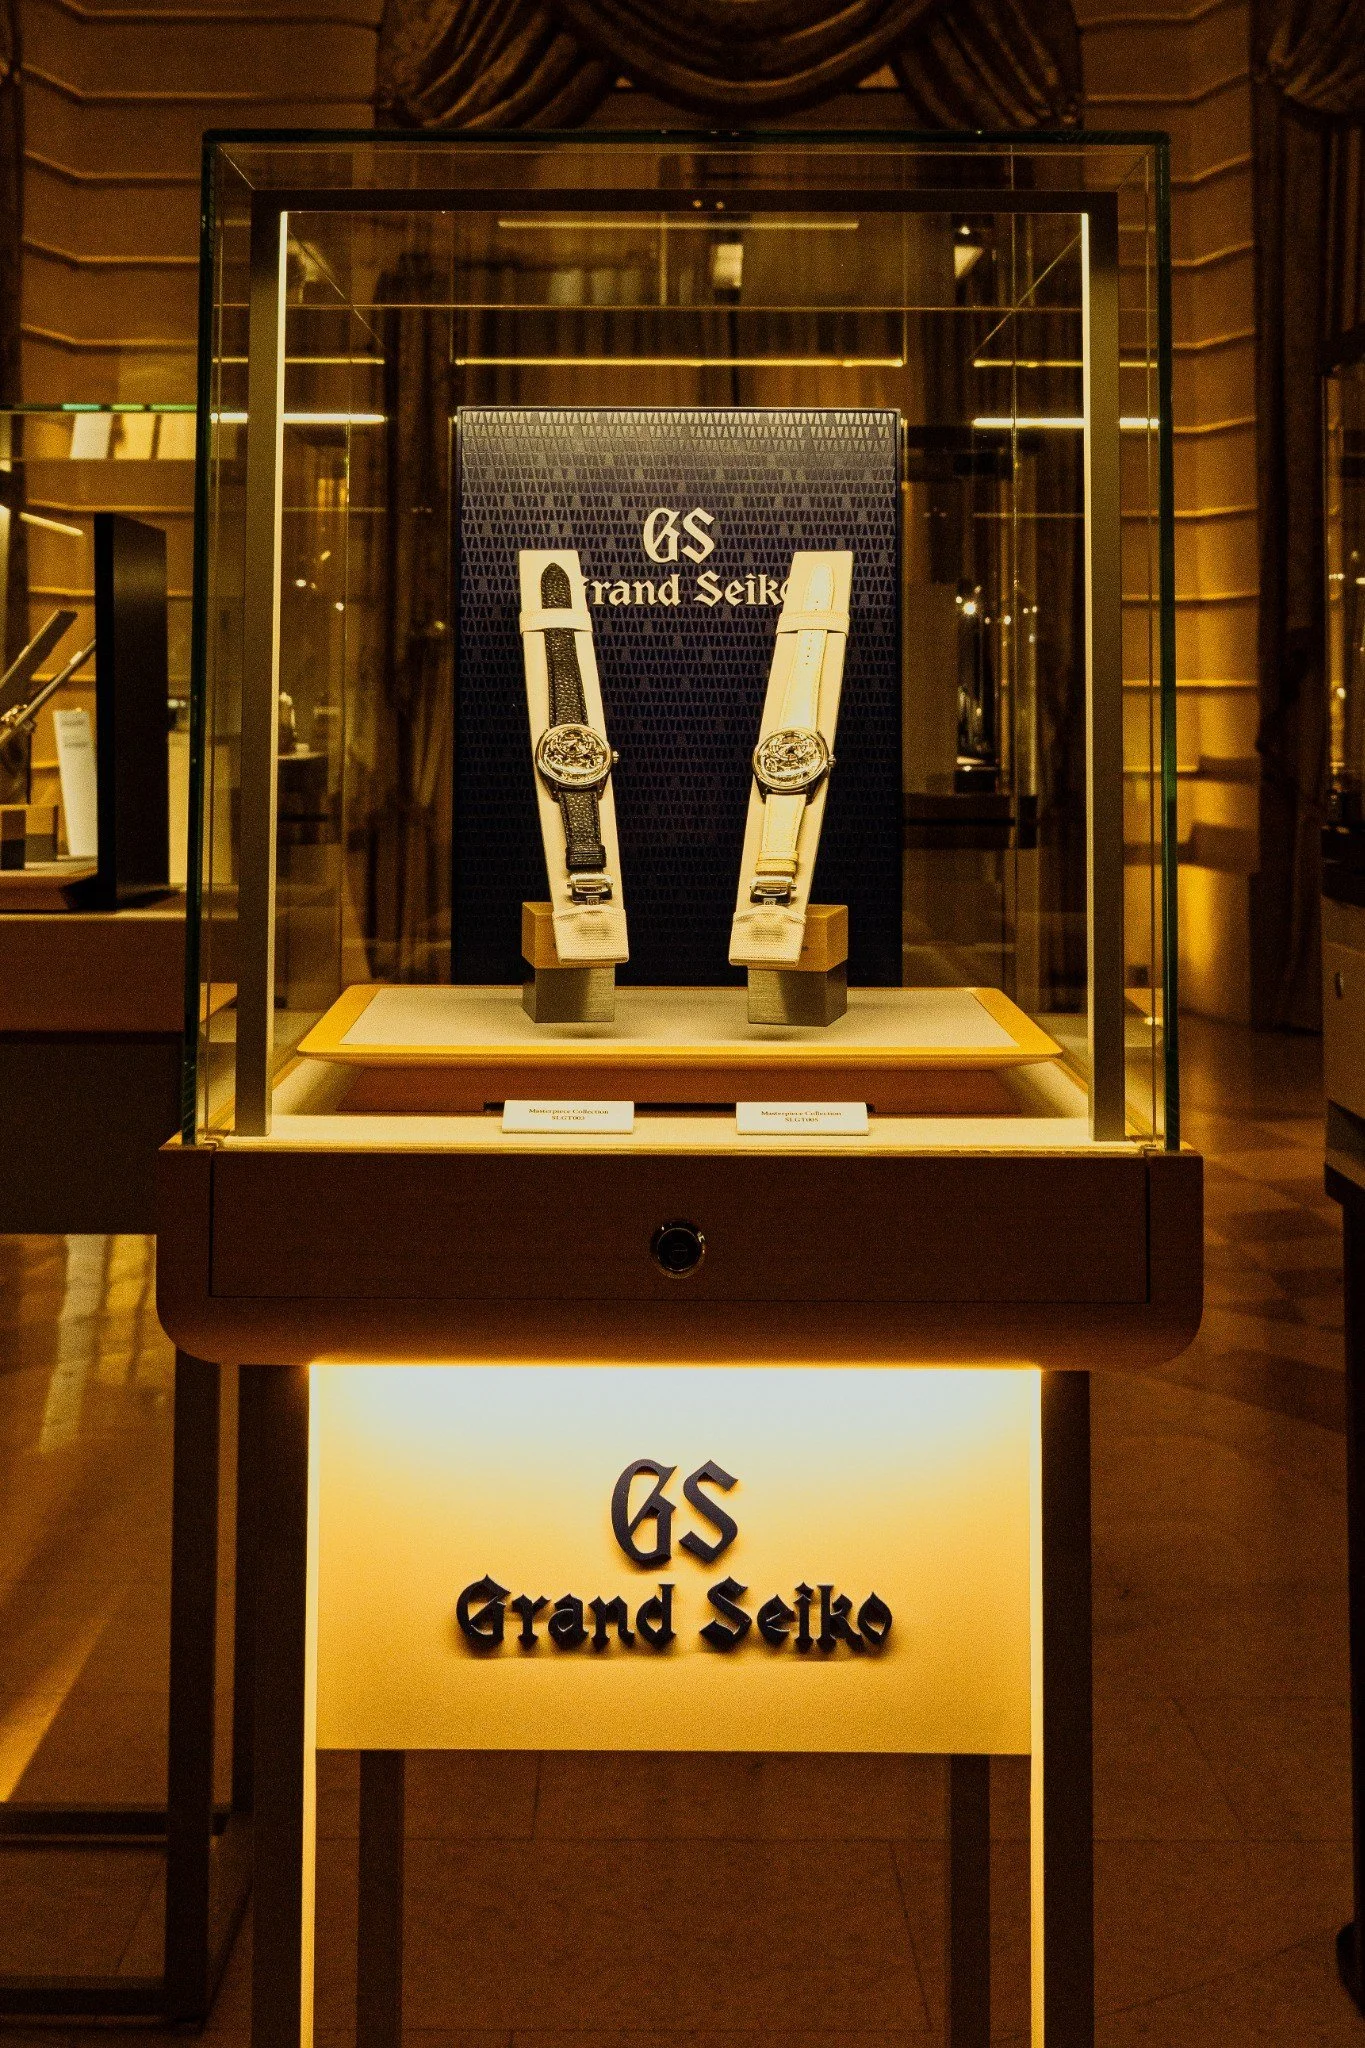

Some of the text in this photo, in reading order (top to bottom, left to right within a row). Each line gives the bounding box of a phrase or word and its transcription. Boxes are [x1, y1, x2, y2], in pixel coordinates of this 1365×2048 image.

[642, 507, 716, 564] GS
[583, 573, 682, 607] rand
[611, 1458, 739, 1567] GS
[455, 1573, 893, 1653] Grand Seiko
